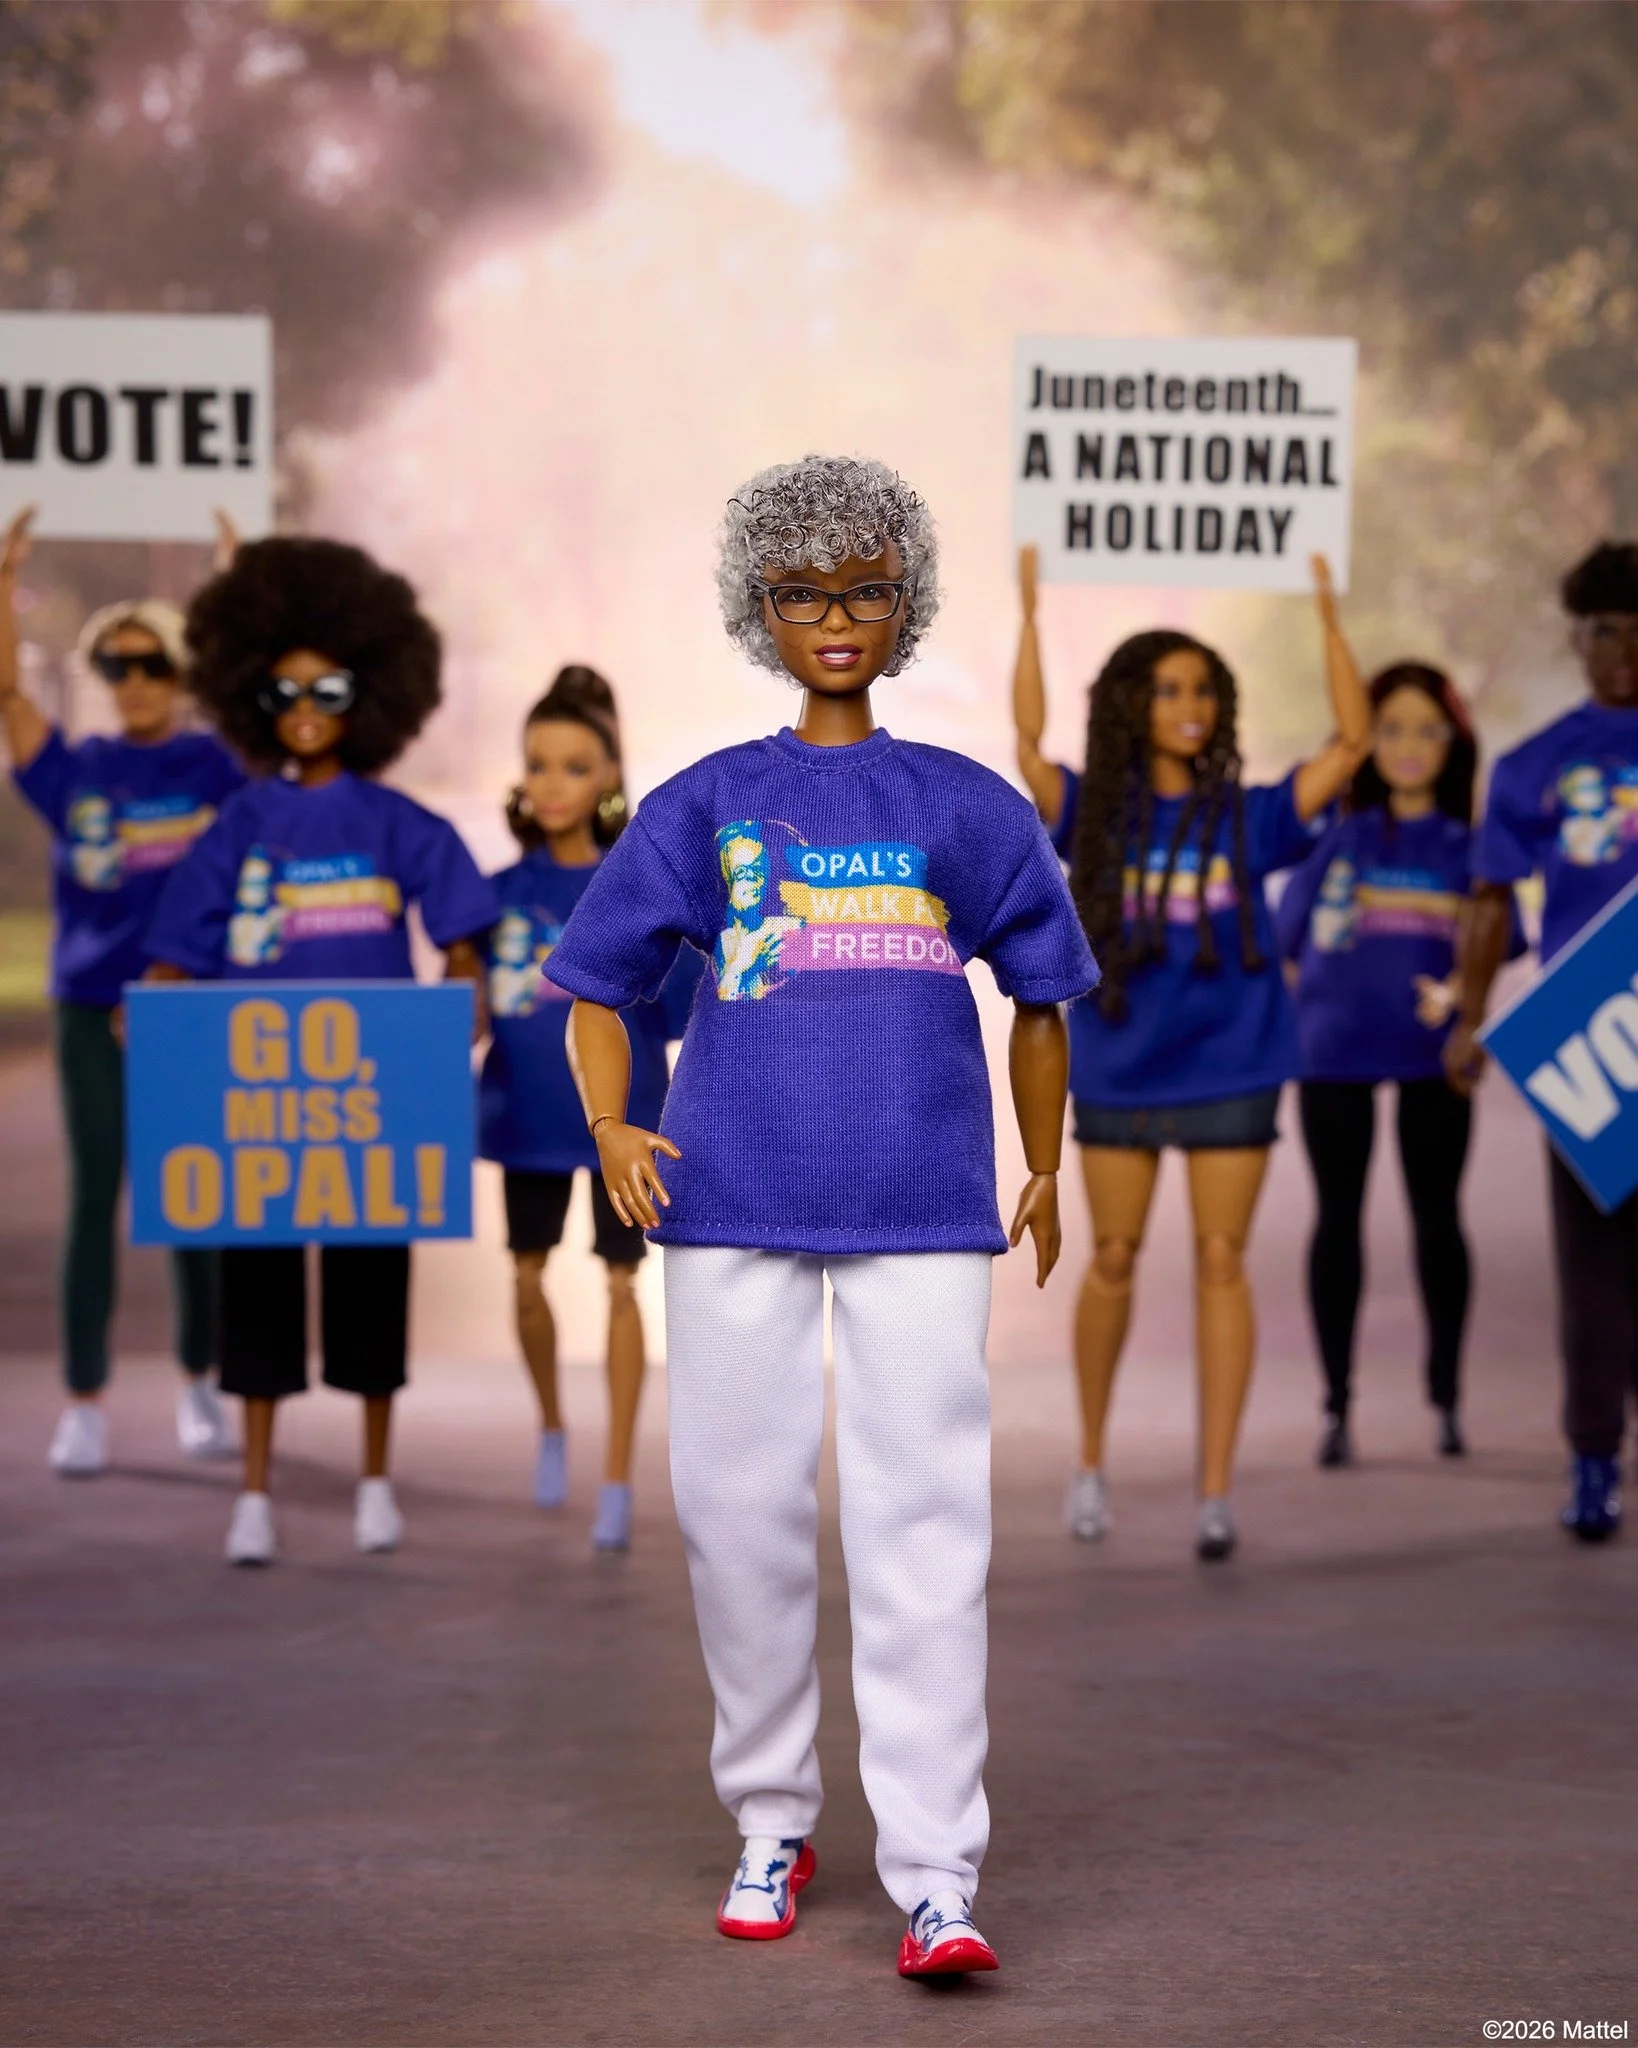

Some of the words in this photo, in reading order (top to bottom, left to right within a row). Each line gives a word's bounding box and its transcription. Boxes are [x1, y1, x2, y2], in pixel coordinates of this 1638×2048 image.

[0, 383, 254, 467] VOTE!
[1022, 432, 1052, 481] A
[1075, 433, 1339, 487] NATIONAL
[1065, 503, 1294, 555] HOLIDAY
[801, 852, 912, 878] OPAL'S
[810, 891, 900, 920] WALK
[228, 998, 378, 1084] GO,
[1524, 970, 1638, 1142] VO
[224, 1086, 383, 1142] MISS
[161, 1144, 447, 1232] OPAL!
